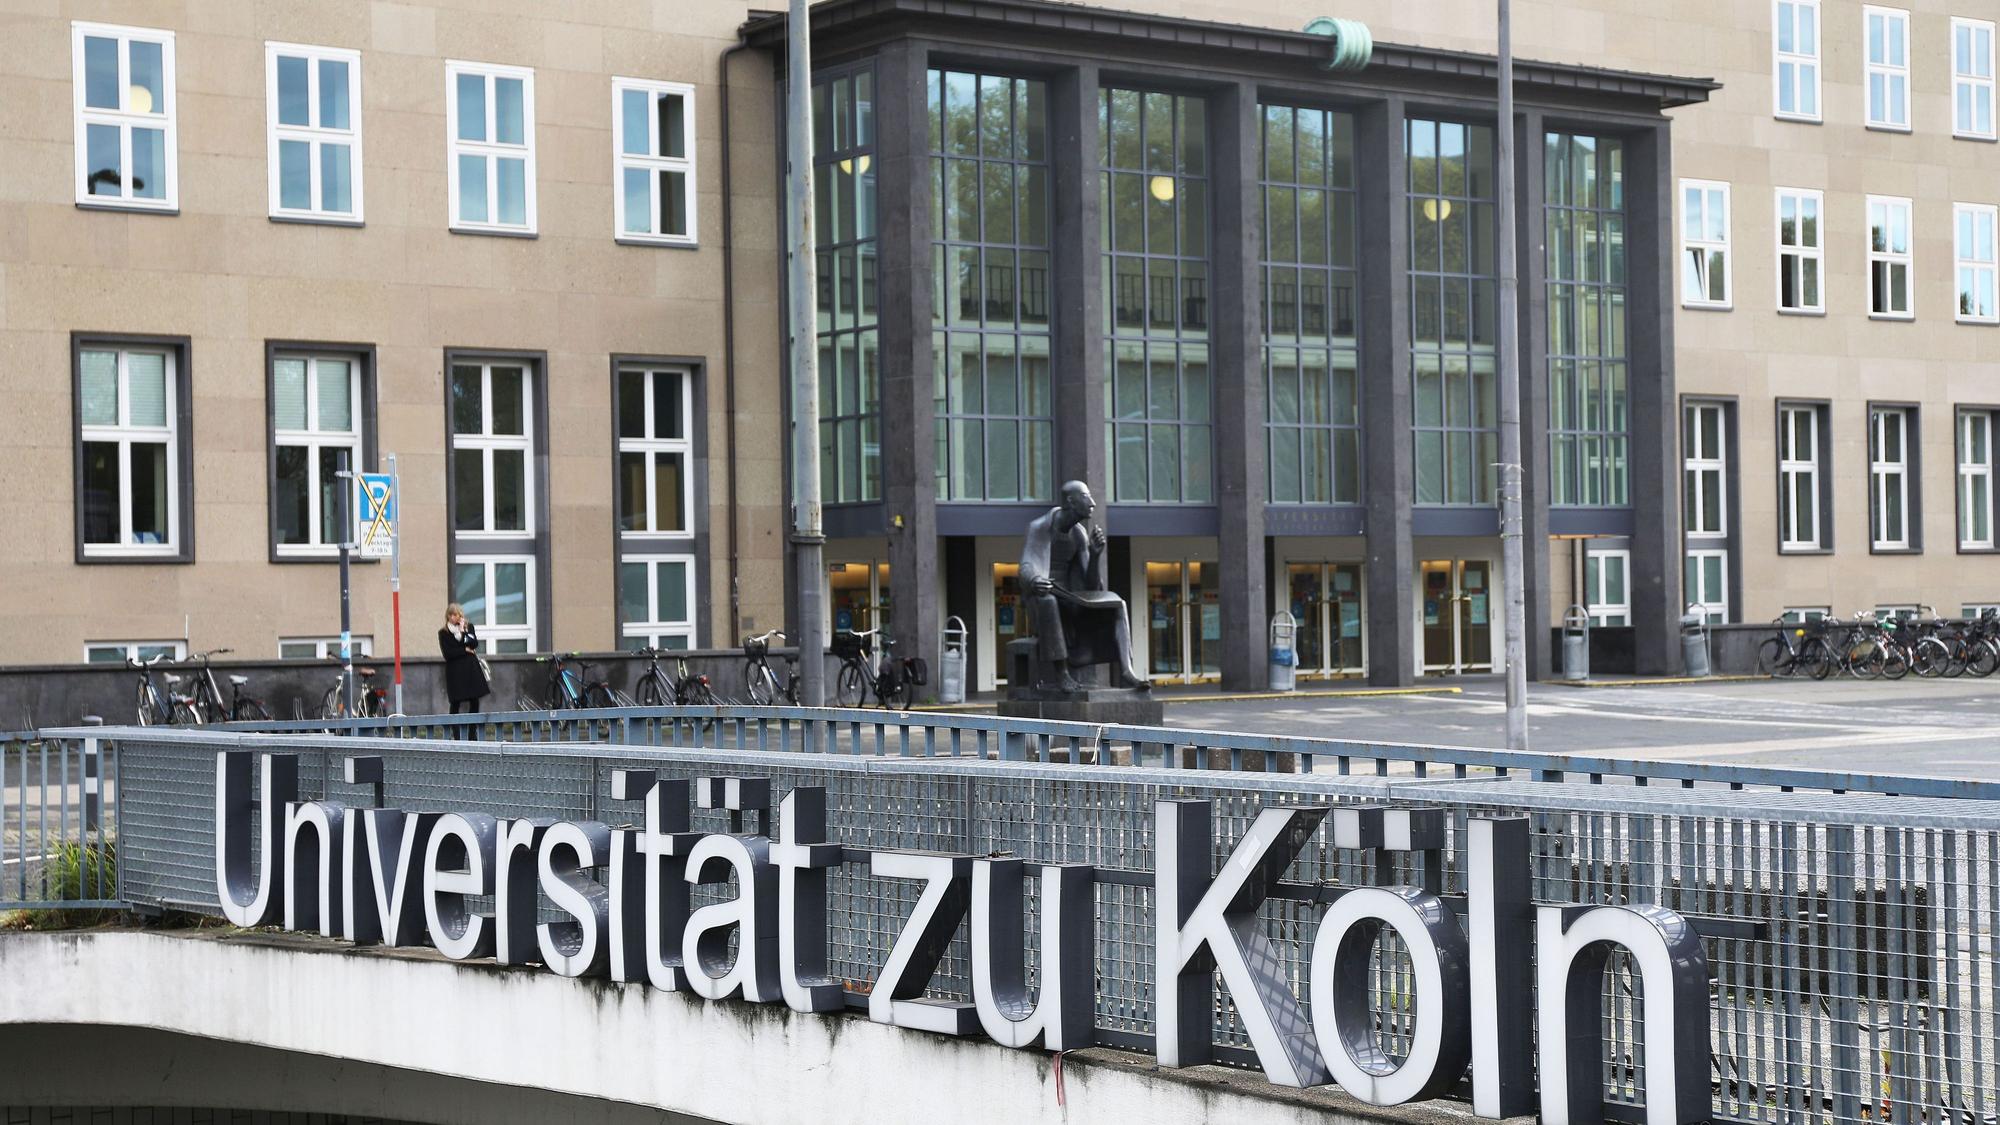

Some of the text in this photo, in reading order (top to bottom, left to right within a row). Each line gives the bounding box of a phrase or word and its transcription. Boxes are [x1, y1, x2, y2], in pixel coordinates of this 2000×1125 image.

[216, 752, 1675, 1125] Universität zu Köln
